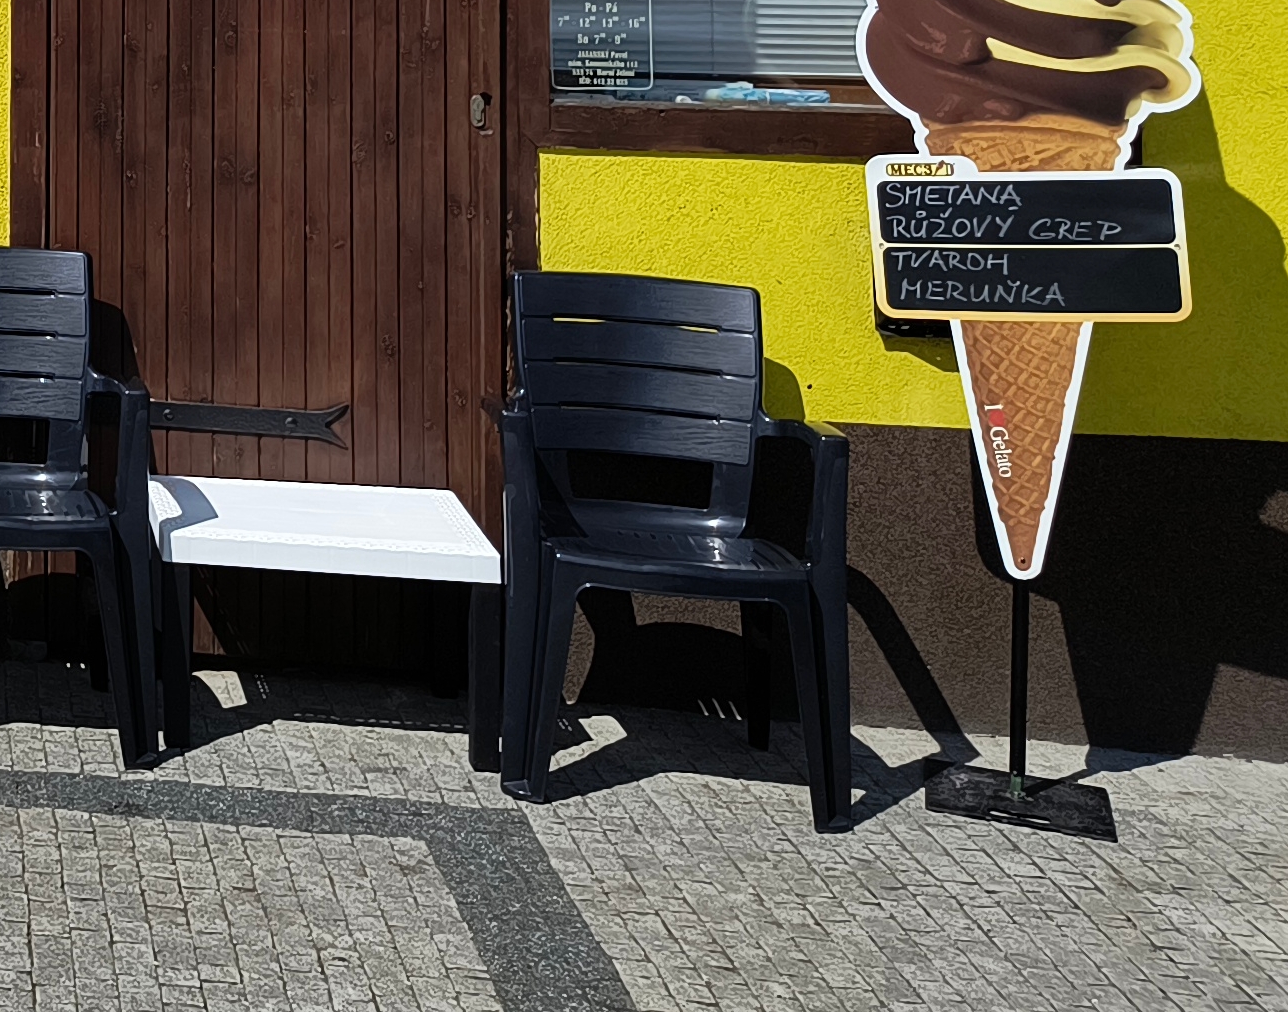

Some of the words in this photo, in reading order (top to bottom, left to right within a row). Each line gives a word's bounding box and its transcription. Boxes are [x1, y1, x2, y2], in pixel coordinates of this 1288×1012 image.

[584, 2, 597, 13] Po
[605, 1, 618, 13] Pá
[577, 33, 589, 44] So
[889, 163, 934, 176] MEC3
[885, 182, 1023, 208] SMETANA
[885, 207, 1015, 238] RŮŽOVÝ
[1028, 218, 1122, 241] GREP
[890, 249, 1009, 275] TVAROH
[900, 278, 1066, 307] MERUŇKA
[989, 426, 1013, 478] Gelato
